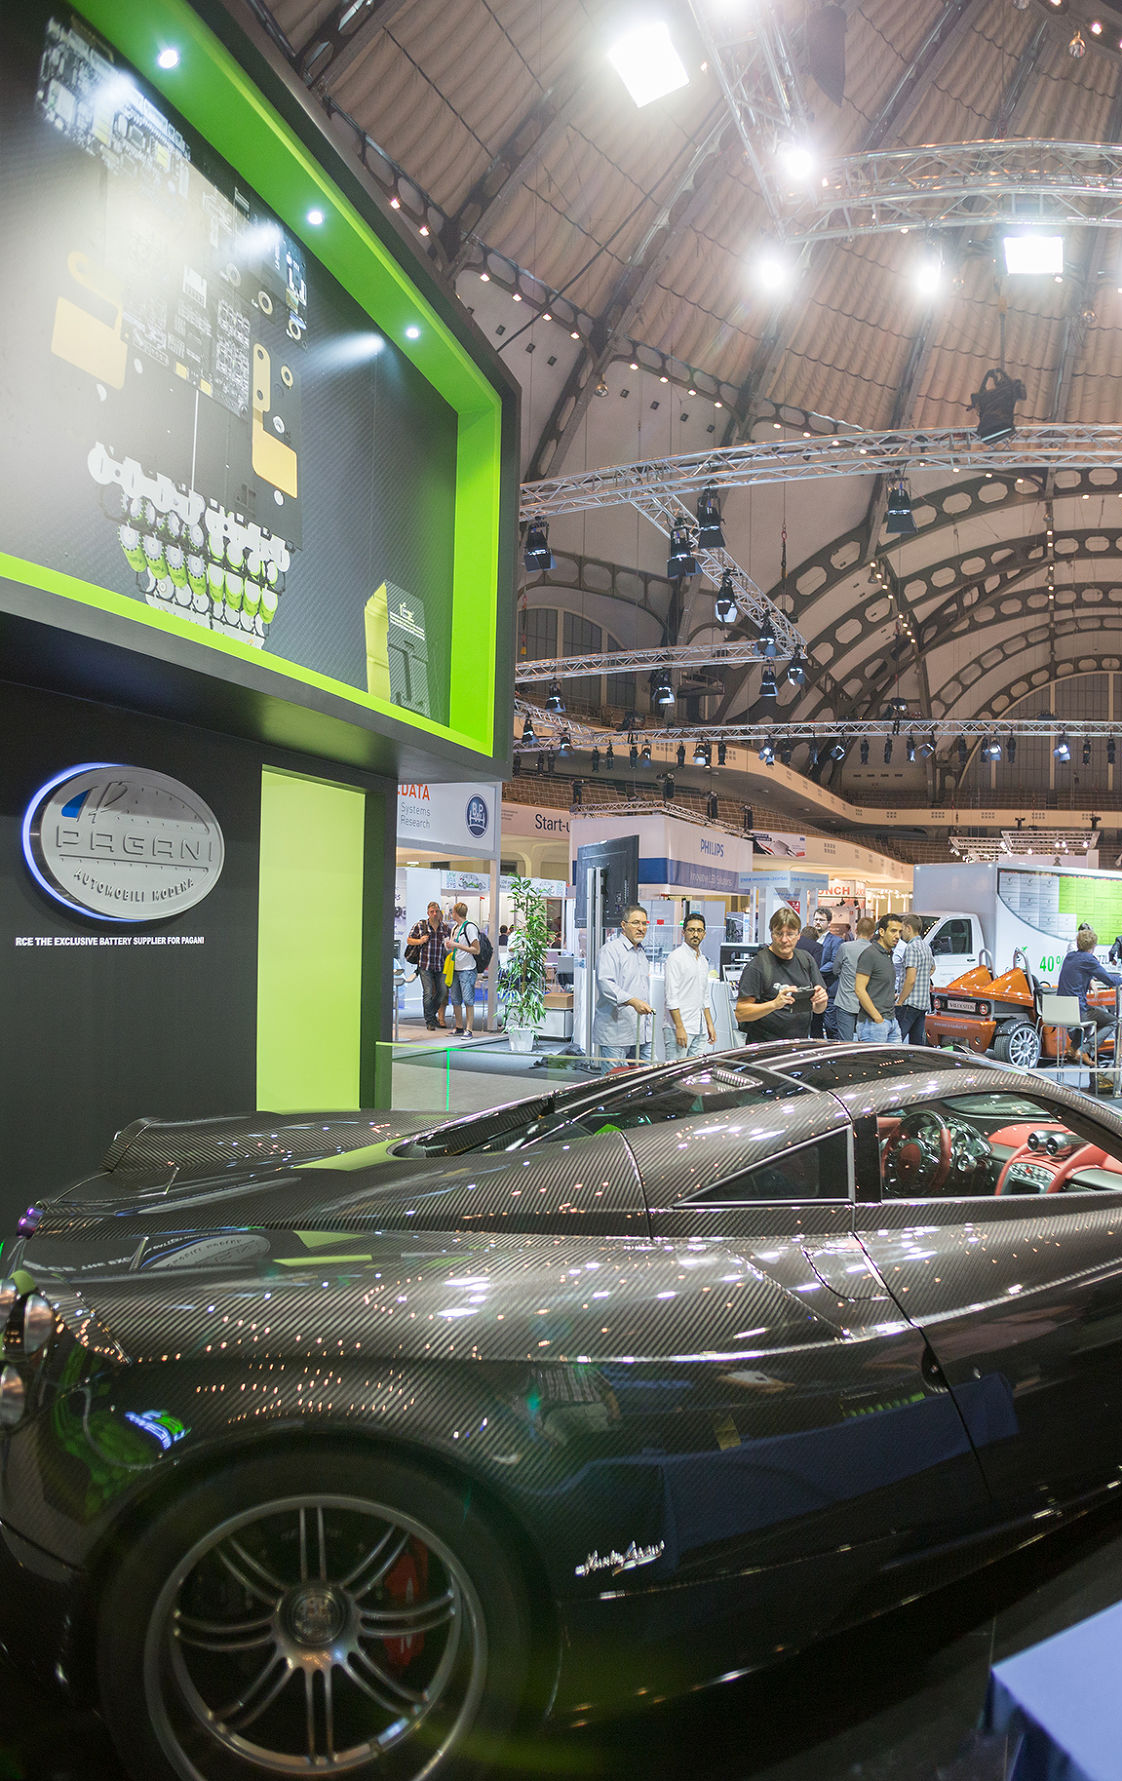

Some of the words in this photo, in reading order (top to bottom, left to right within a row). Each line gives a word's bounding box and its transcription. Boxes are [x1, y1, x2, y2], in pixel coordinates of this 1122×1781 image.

[400, 801, 431, 817] Systems
[400, 814, 431, 829] Research
[56, 825, 213, 862] PAGANI
[700, 838, 724, 857] PHILIPS
[73, 867, 146, 903] AUTOMOBILI
[151, 877, 195, 902] MODENA
[15, 937, 34, 947] RCE
[34, 937, 53, 947] THE
[54, 937, 98, 946] EXCLUSIVE
[99, 937, 133, 946] BATTERY
[133, 936, 167, 945] SUPPLIER
[167, 936, 181, 945] FOR
[181, 936, 205, 945] PAGANI
